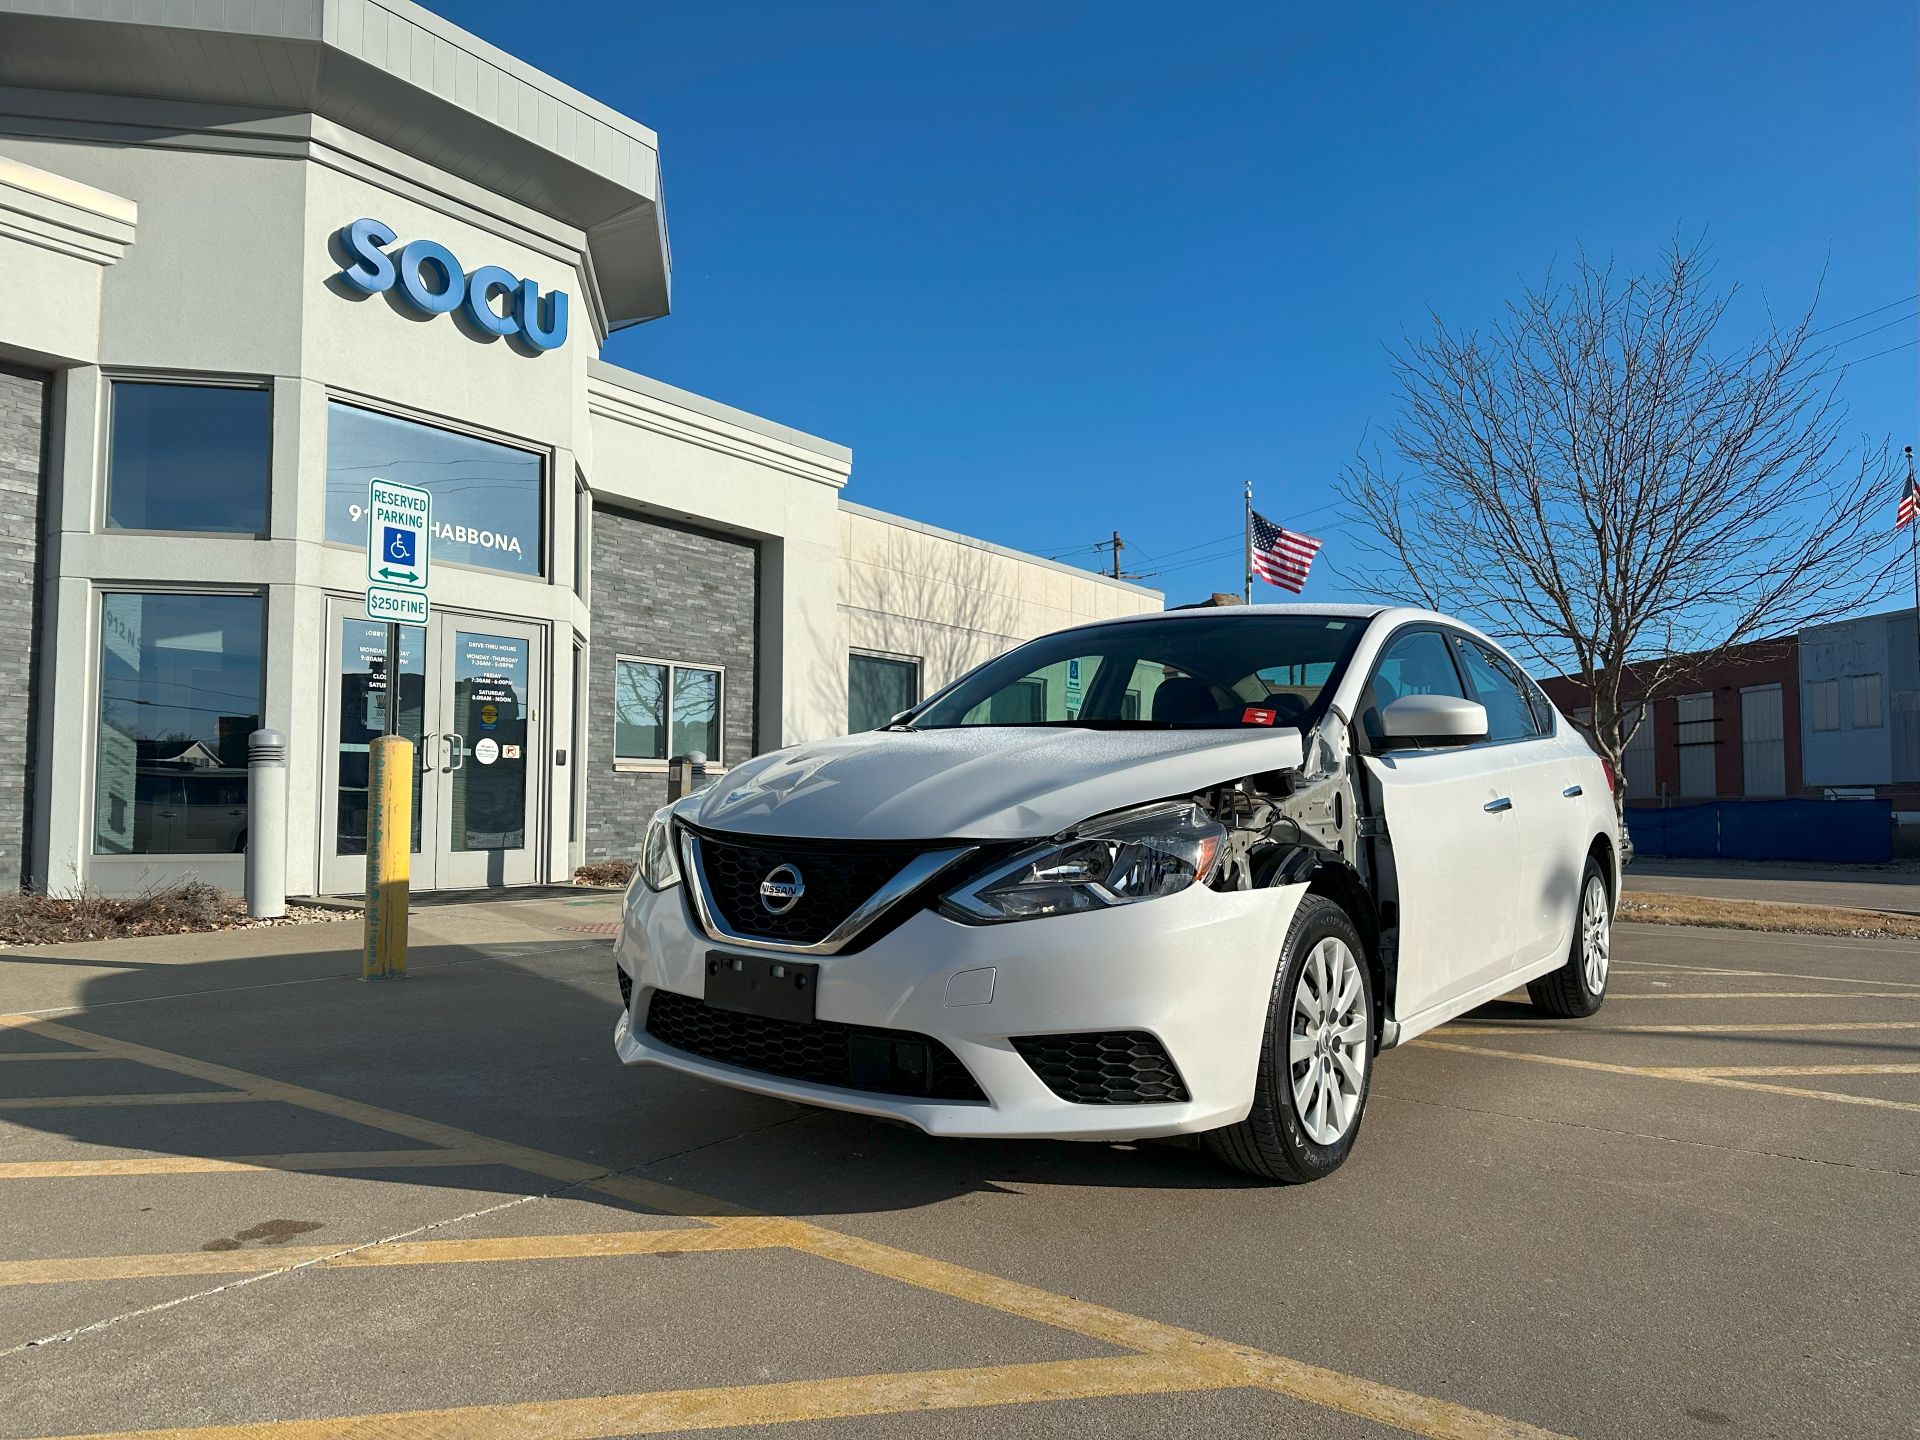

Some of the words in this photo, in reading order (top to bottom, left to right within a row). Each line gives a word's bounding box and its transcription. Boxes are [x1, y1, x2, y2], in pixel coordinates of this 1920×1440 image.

[341, 217, 568, 350] SOCU
[374, 490, 426, 512] RESERVED
[377, 507, 423, 529] PARKING
[371, 595, 399, 611] $250
[400, 600, 425, 614] FINE
[762, 884, 797, 895] NISSAN
